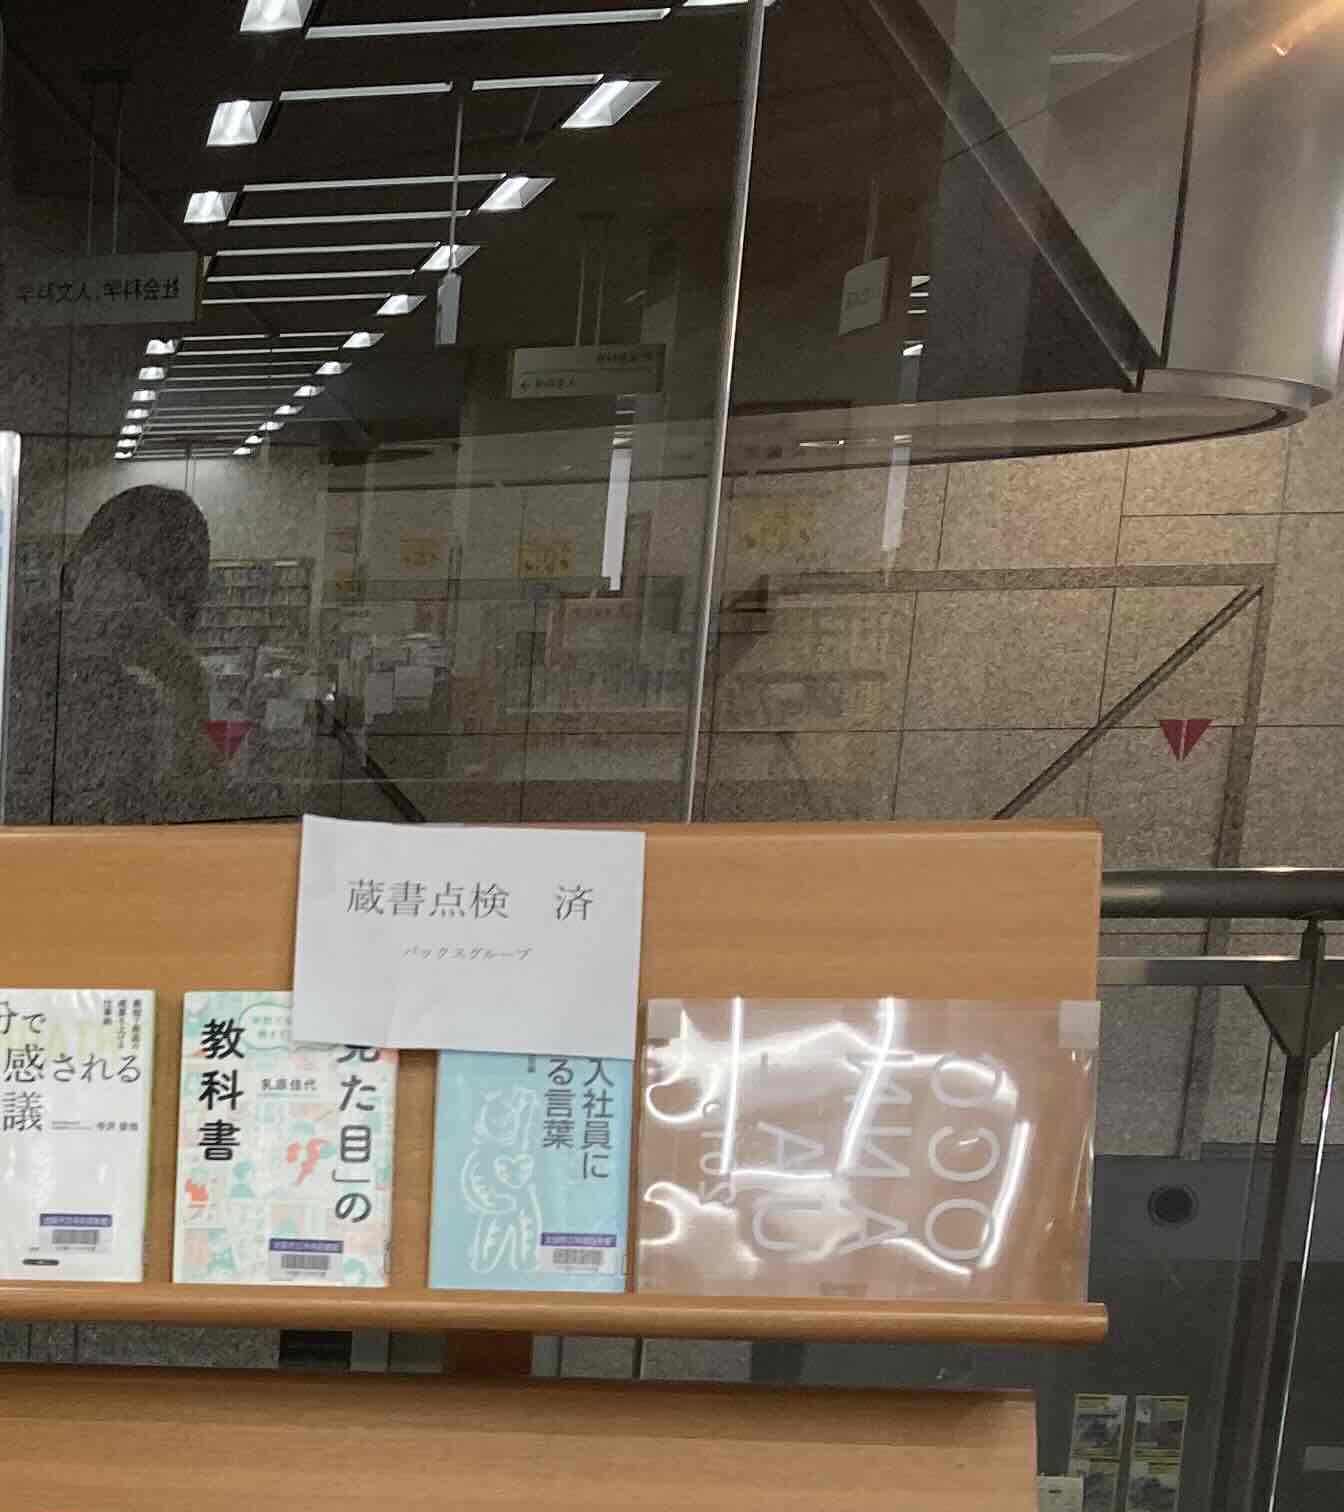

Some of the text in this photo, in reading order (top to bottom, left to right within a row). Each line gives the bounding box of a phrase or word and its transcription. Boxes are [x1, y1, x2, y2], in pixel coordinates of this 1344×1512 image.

[345, 878, 594, 921] 蔵書点検 済
[198, 1018, 245, 1161] 教科書
